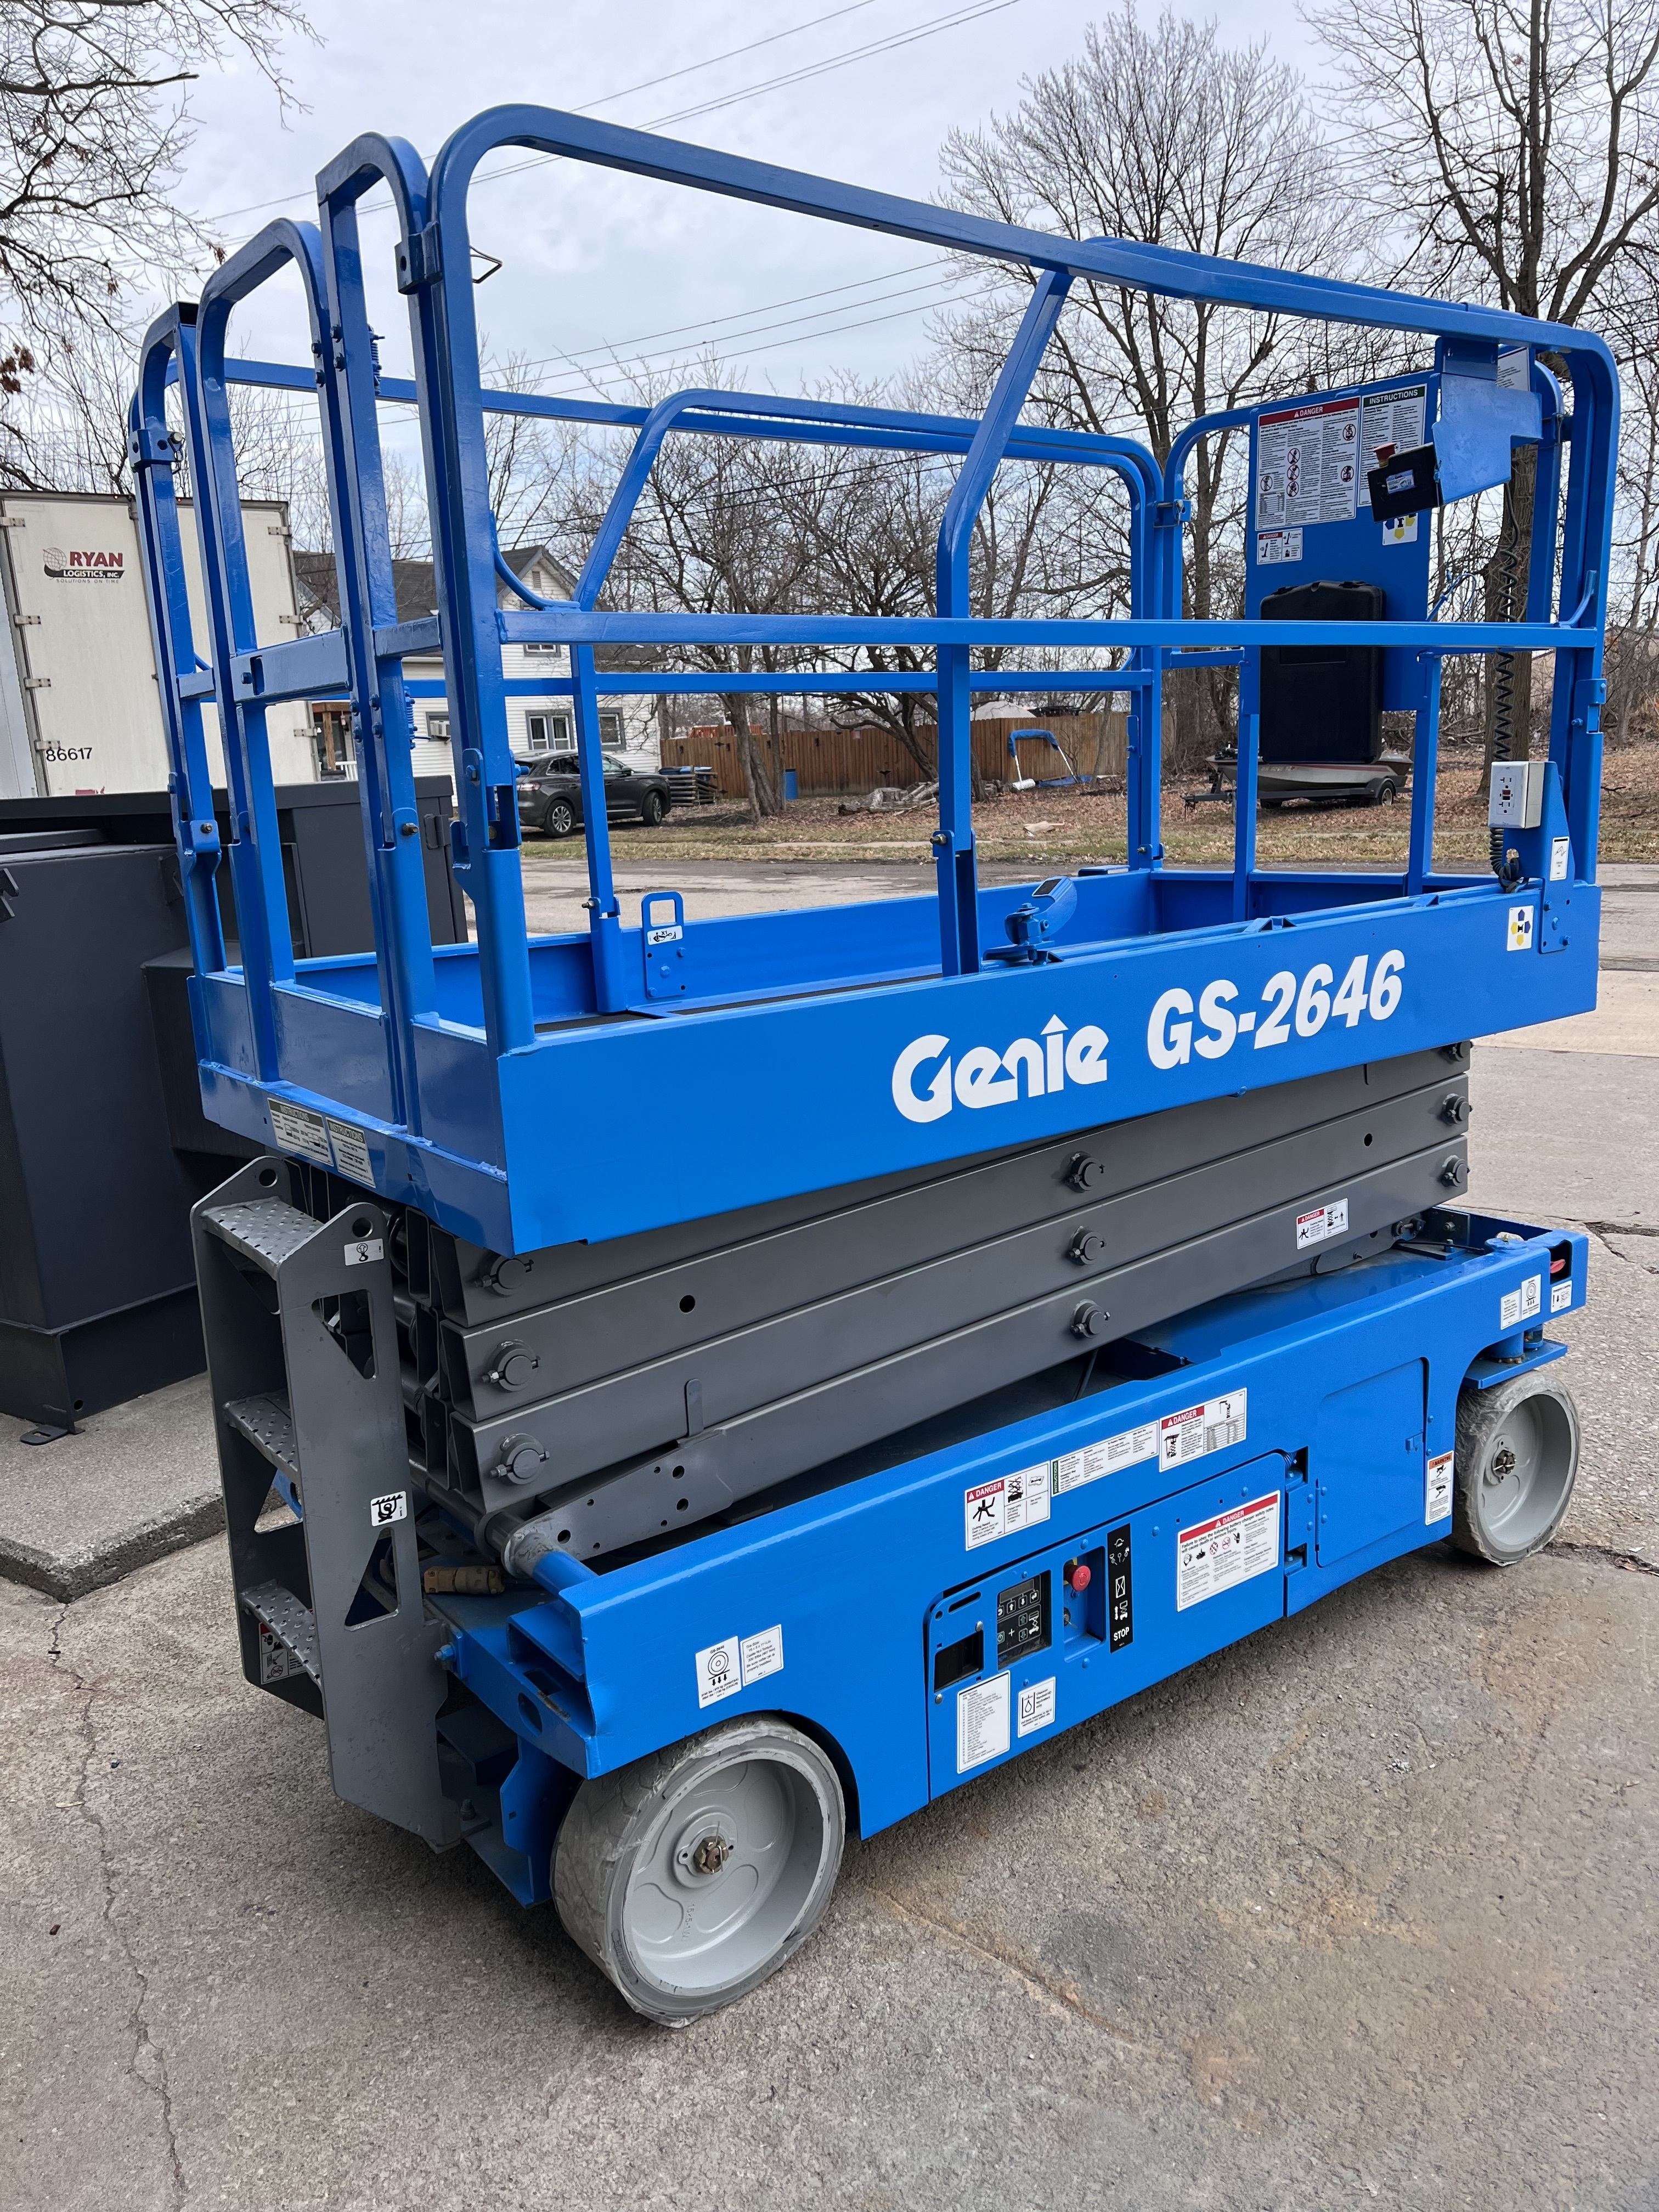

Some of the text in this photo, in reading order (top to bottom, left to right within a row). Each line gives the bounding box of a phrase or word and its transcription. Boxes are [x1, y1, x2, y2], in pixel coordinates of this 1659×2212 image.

[1369, 389, 1418, 404] INSTRUCTIONS
[1299, 406, 1323, 417] DANGER
[70, 551, 123, 567] RYAN
[63, 569, 106, 578] LOGISTICS,
[46, 747, 93, 761] 86617
[891, 949, 1406, 1123] Genie GS-2646
[329, 1121, 363, 1142] INSTRUCTIONS
[1305, 1211, 1320, 1221] DANGER
[1173, 1409, 1197, 1424] DANGER
[1435, 1454, 1451, 1465] WARNING
[975, 1482, 1002, 1497] DANGER
[1222, 1509, 1245, 1525] DANGER
[1242, 1515, 1255, 1523] charger
[1114, 1626, 1130, 1641] STOP
